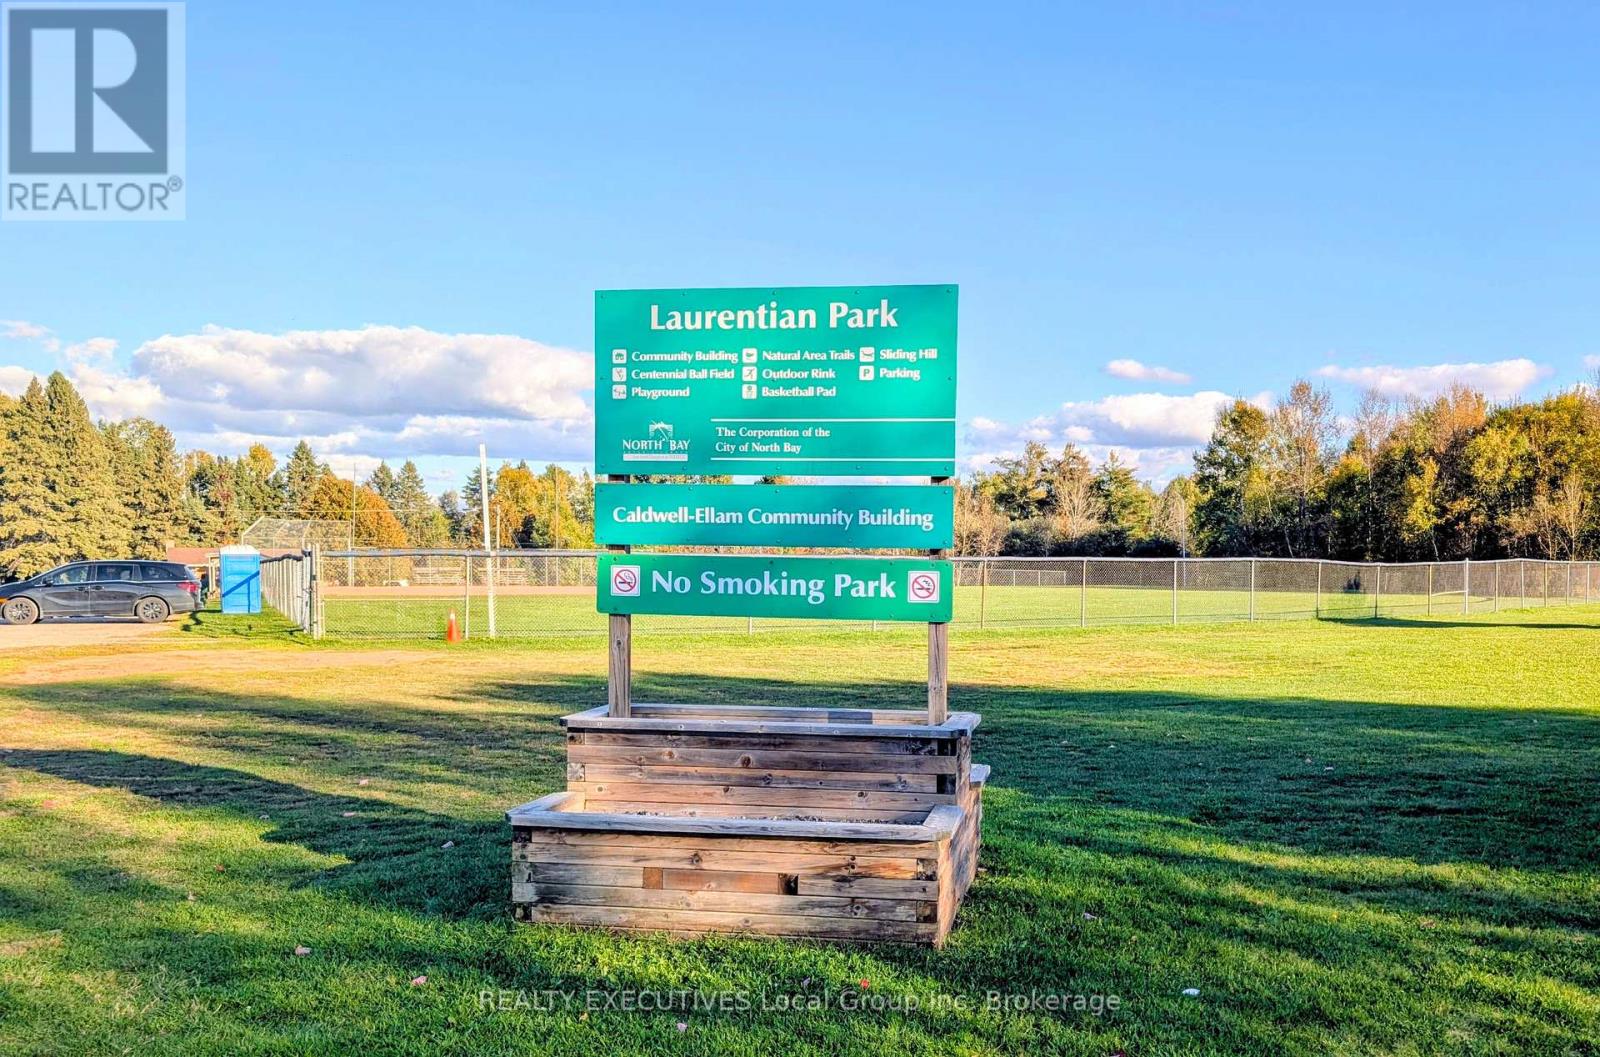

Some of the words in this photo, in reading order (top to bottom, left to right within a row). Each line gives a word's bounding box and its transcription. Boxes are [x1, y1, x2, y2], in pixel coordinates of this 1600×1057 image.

[651, 301, 816, 331] Laurentian
[829, 299, 898, 329] Park
[631, 351, 693, 363] Community
[695, 350, 738, 364] Building
[762, 350, 800, 361] Natural
[802, 350, 827, 360] Area
[829, 350, 855, 360] Trails
[879, 348, 917, 362] Sliding
[919, 348, 938, 359] Hill
[631, 369, 687, 379] Centennial
[689, 369, 708, 379] Ball
[710, 369, 735, 379] Field
[762, 368, 809, 379] Outdoor
[811, 368, 836, 378] Rink
[863, 369, 870, 378] P
[879, 367, 920, 381] Parking
[631, 387, 690, 399] Playground
[762, 386, 814, 397] Basketball
[816, 386, 836, 396] Pad
[715, 427, 736, 437] The
[739, 427, 799, 439] Corporation
[802, 427, 814, 436] of
[815, 427, 831, 437] the
[622, 440, 662, 450] NORTH
[669, 439, 690, 451] BAY
[715, 442, 736, 453] City
[739, 442, 749, 452] of
[752, 442, 780, 453] North
[783, 442, 802, 454] Bay
[613, 506, 743, 525] Caldwell-Ellam
[748, 508, 853, 530] Community
[858, 509, 934, 531] Building
[651, 570, 691, 594] No
[700, 571, 825, 604] Smoking
[834, 574, 896, 598] Park
